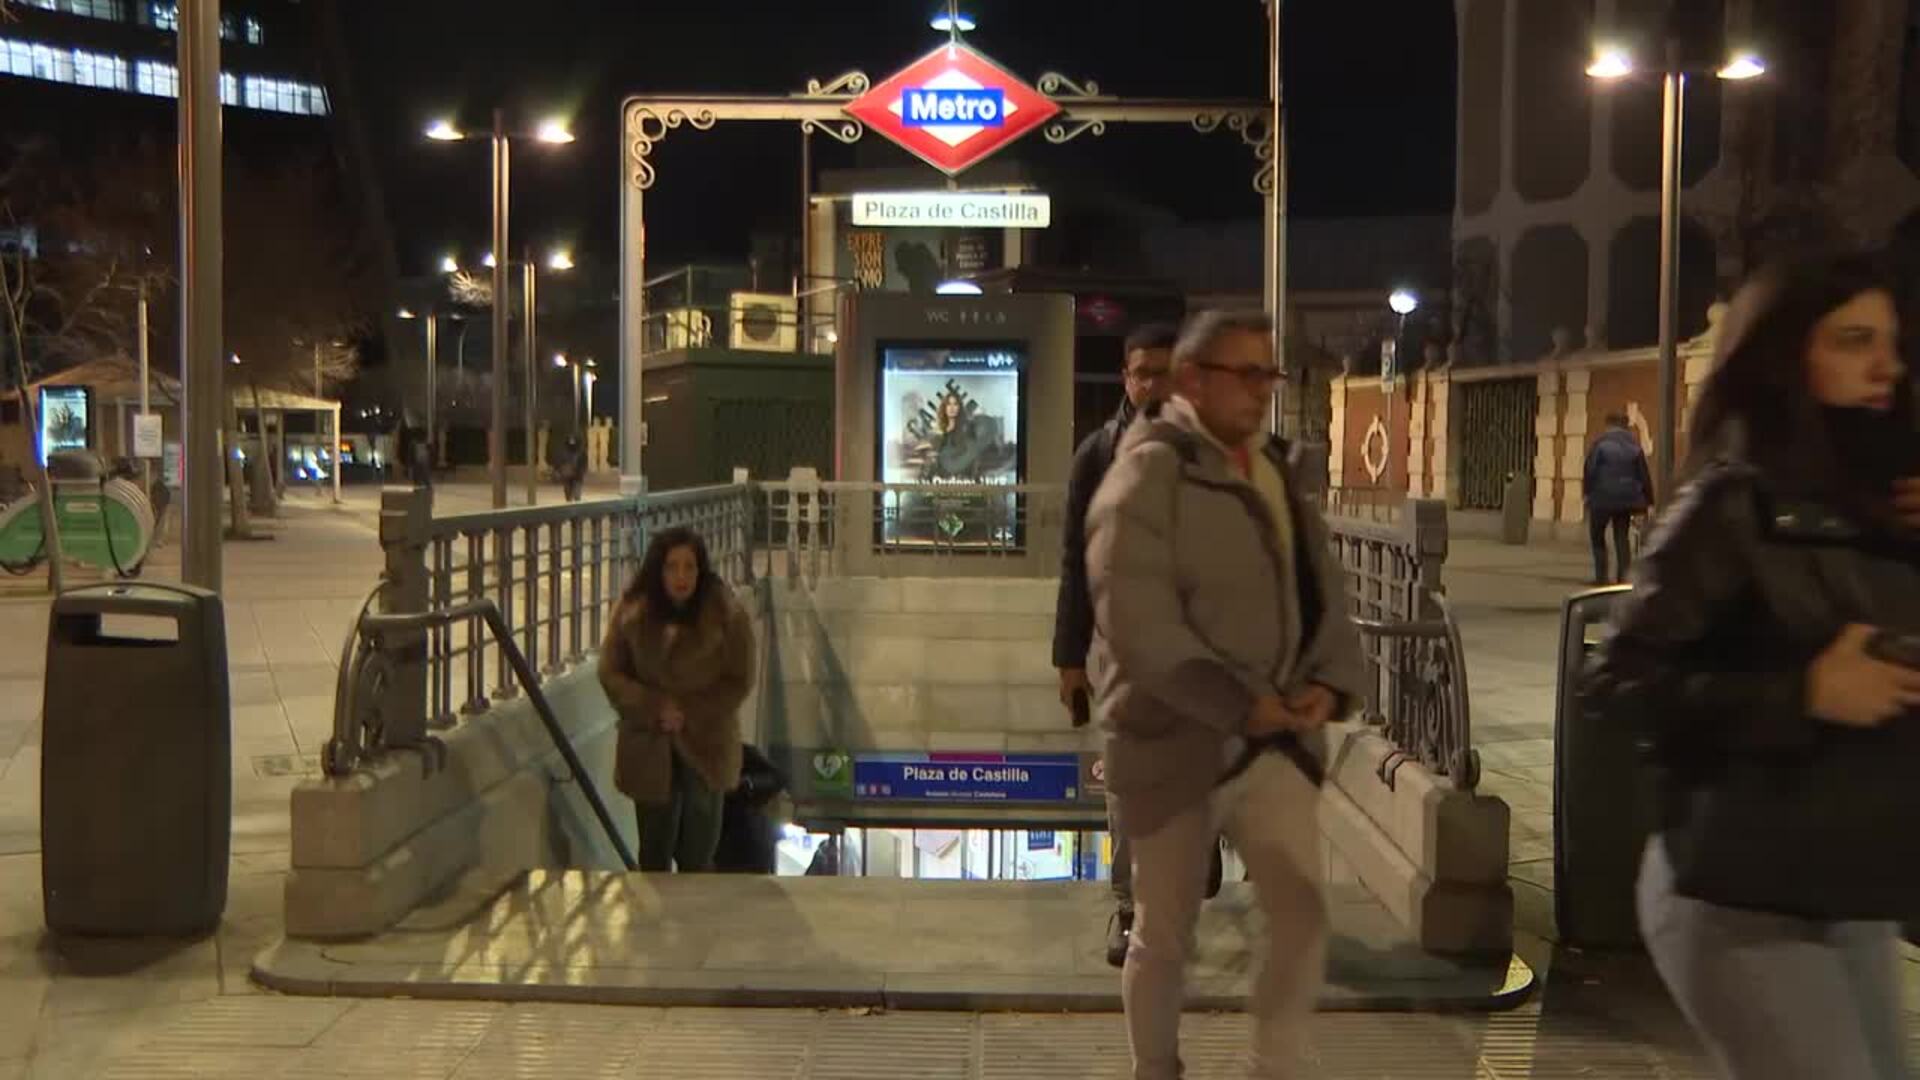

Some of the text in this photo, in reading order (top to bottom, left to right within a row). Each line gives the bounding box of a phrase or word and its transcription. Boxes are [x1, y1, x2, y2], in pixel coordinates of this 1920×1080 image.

[909, 92, 998, 121] Metro
[864, 201, 1039, 221] Plaza de Castilla
[903, 766, 1030, 783] Plaza de Castilla
